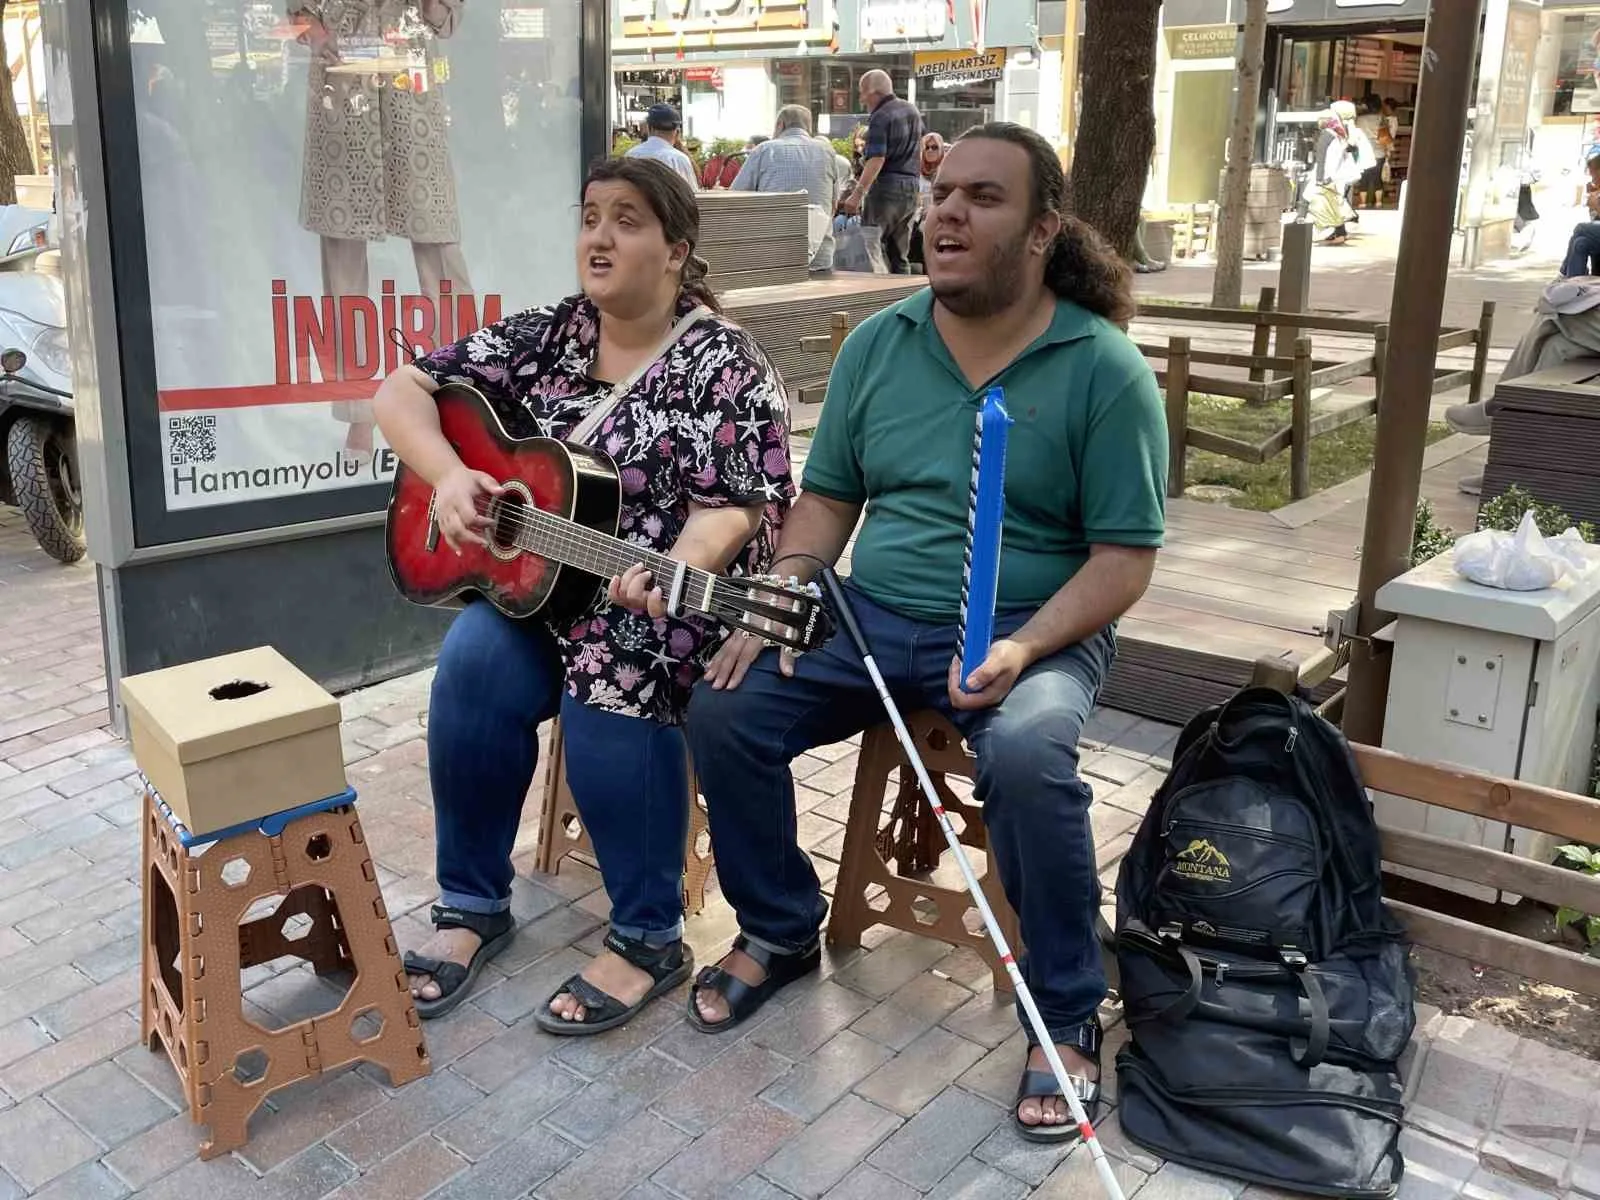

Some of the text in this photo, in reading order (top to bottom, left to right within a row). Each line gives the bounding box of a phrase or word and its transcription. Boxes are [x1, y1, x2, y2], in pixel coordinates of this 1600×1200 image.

[951, 54, 997, 70] KARTSIZ
[173, 451, 359, 495] Hamamyolu
[1176, 861, 1230, 878] MONTANA
